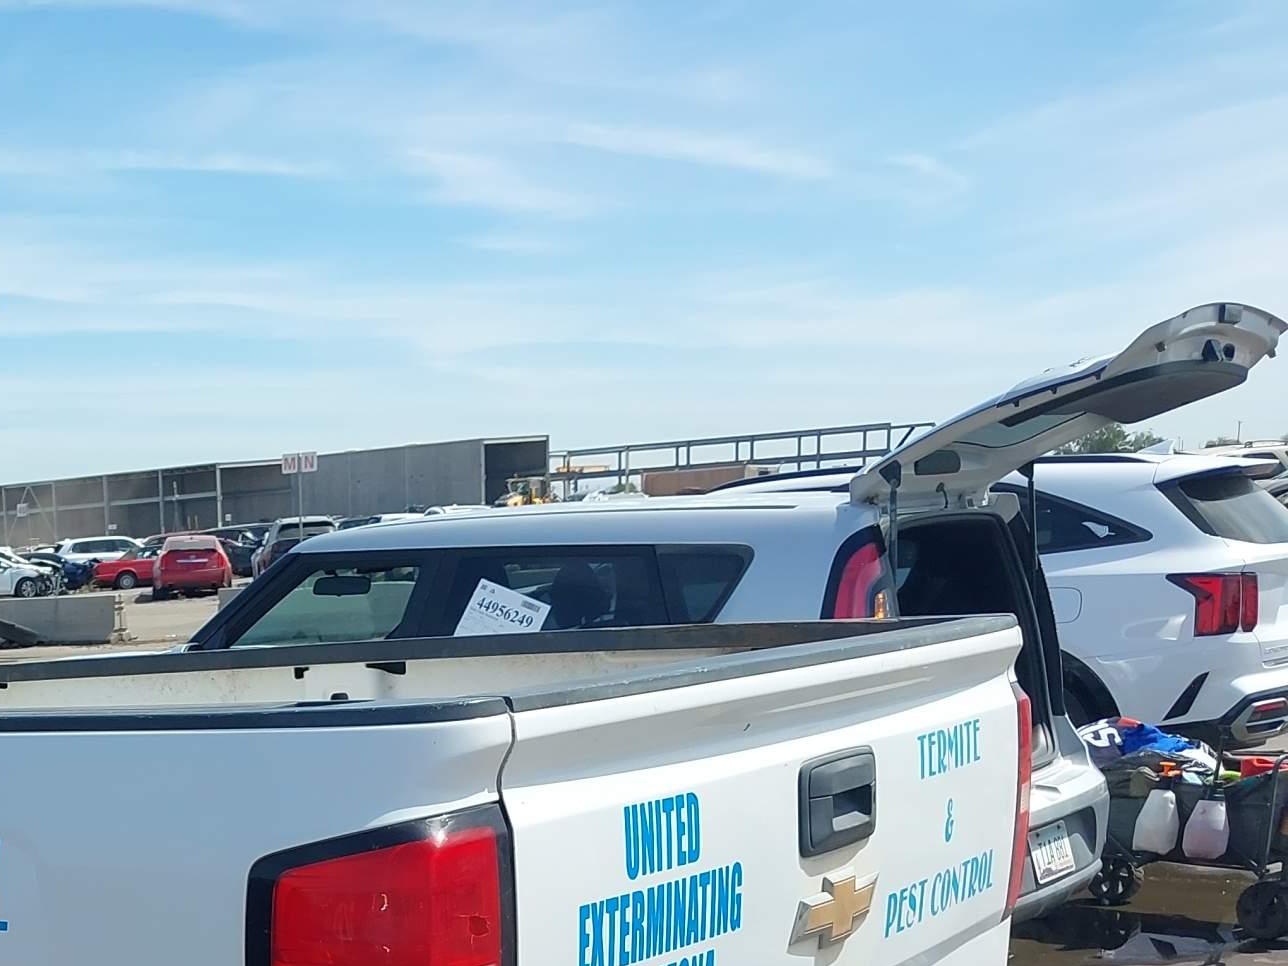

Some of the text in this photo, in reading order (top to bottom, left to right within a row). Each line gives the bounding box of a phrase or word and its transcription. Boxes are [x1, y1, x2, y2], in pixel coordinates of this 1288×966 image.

[284, 457, 296, 471] M
[304, 455, 314, 469] N
[476, 597, 533, 628] 44956249
[917, 719, 981, 780] TERMITE
[623, 792, 701, 881] UNITED
[944, 798, 955, 843] &
[884, 849, 994, 938] PEST CONTROL
